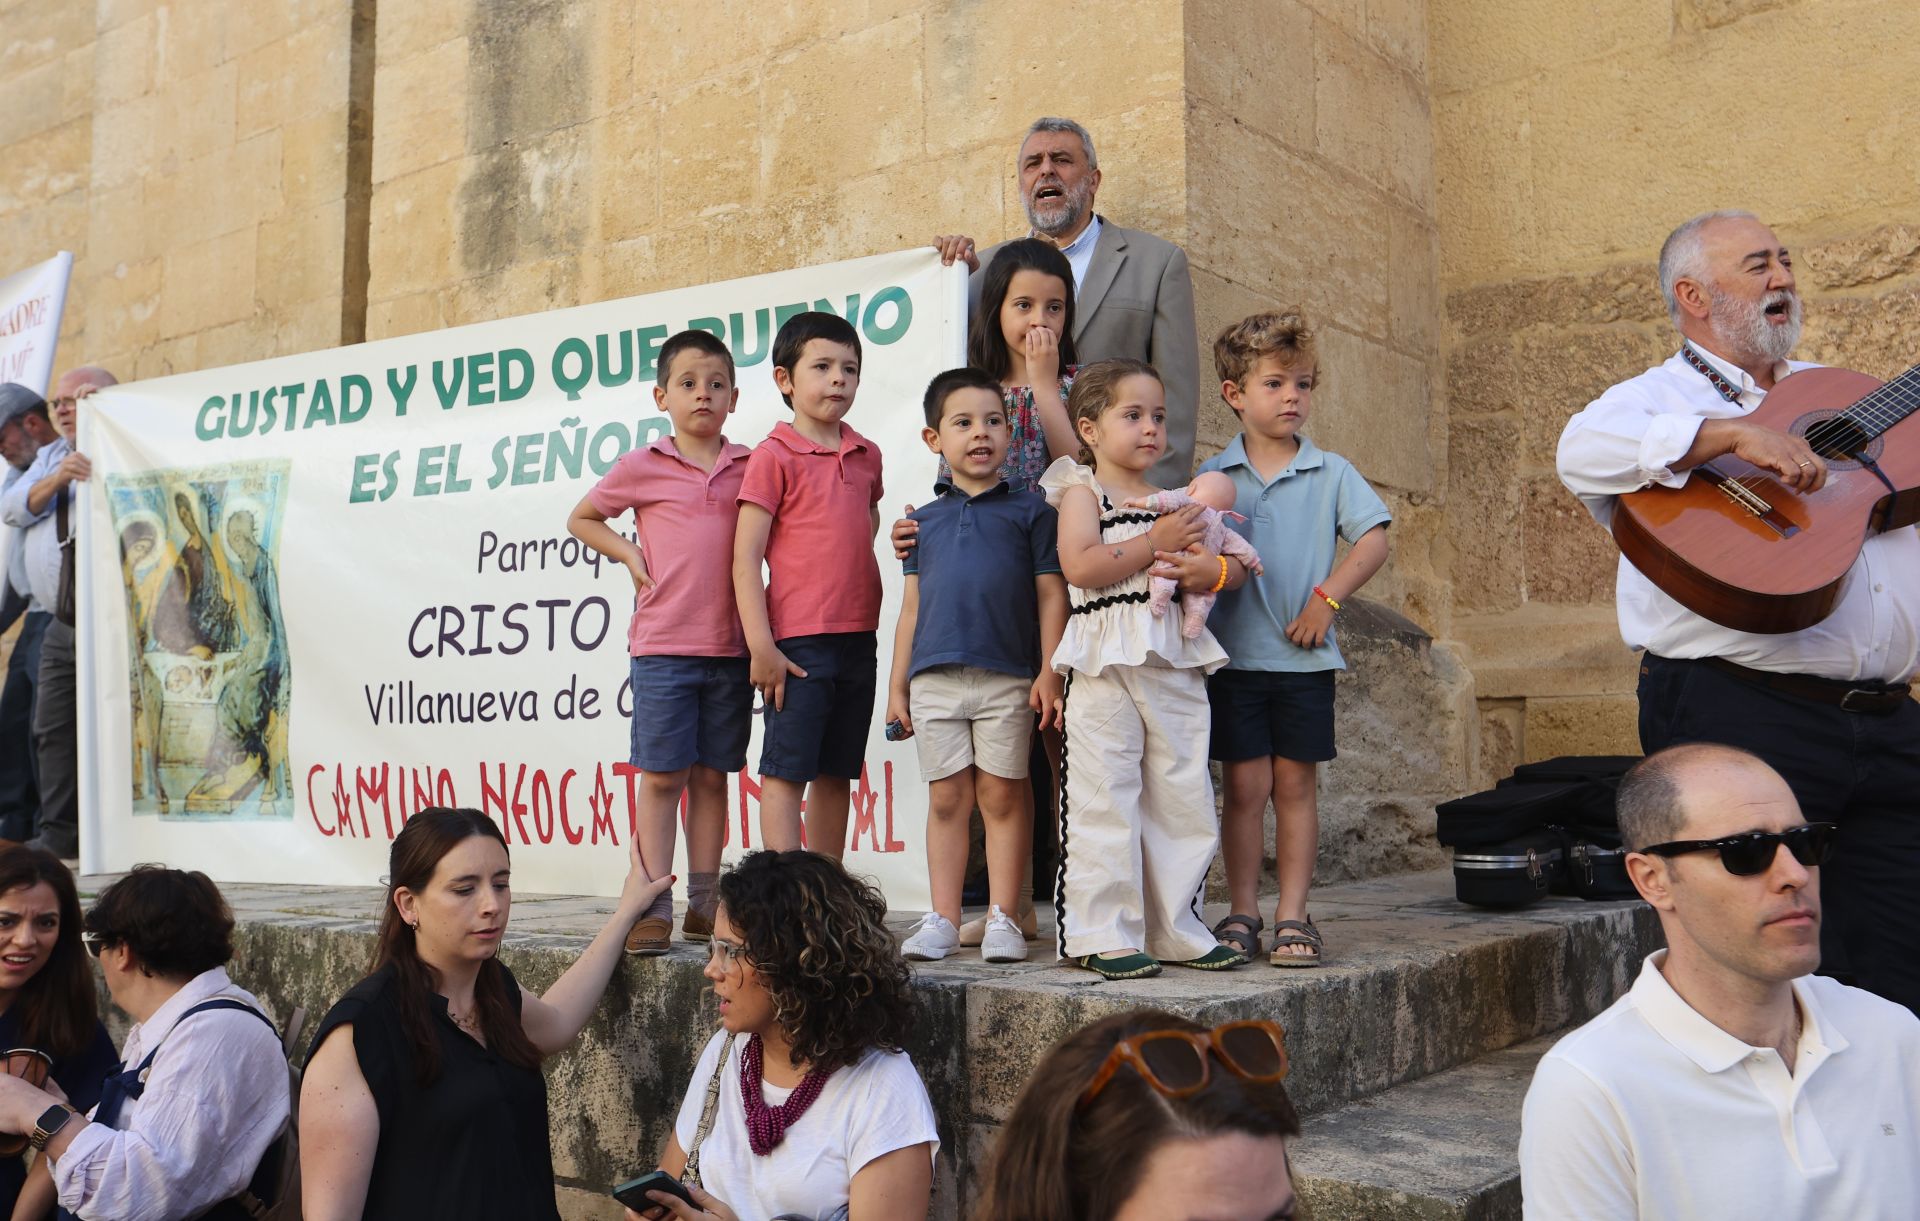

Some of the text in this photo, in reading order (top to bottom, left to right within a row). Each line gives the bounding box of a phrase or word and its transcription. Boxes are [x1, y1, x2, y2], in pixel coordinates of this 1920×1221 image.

[194, 286, 914, 442] GUSTAD Y VED QUE UNO
[348, 453, 400, 504] ES
[414, 446, 471, 497] EL
[408, 595, 611, 659] CRISTO
[364, 679, 539, 726] Villanueva
[553, 673, 602, 721] de
